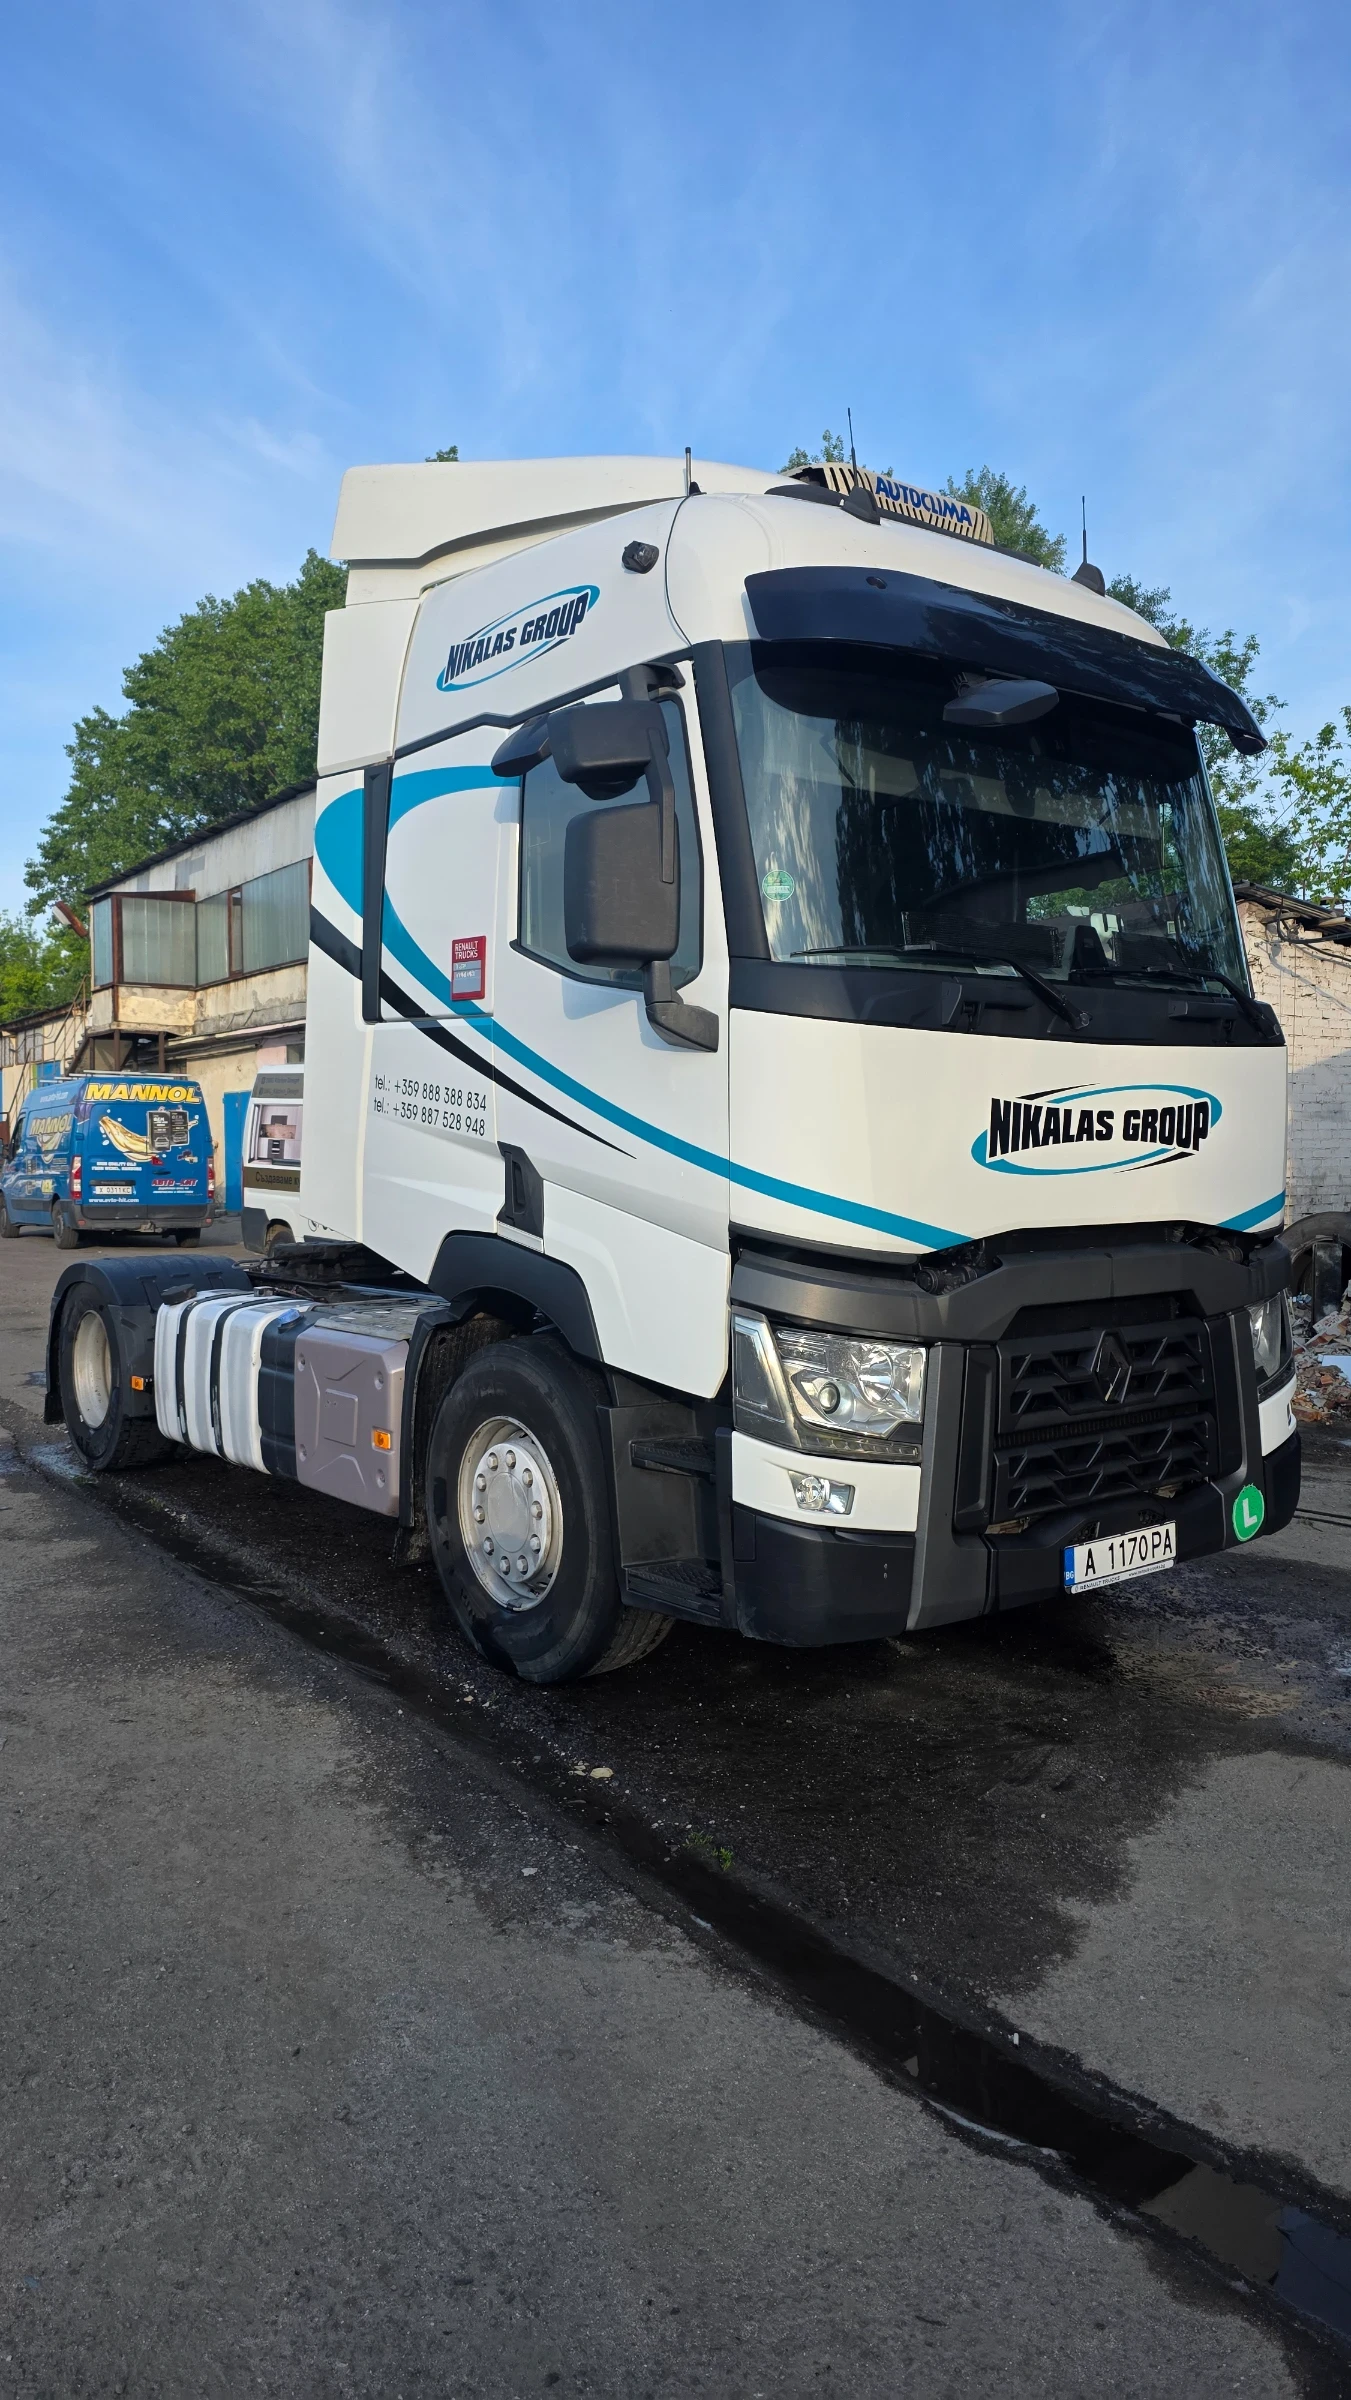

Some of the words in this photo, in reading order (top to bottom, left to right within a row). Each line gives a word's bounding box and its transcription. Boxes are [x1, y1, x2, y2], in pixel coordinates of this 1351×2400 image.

[875, 476, 973, 527] AUTOCLIMA
[444, 627, 517, 684] NIKALAS
[519, 591, 589, 646] GROUP
[454, 941, 479, 952] RENAULT
[454, 950, 479, 960] TRUCKS
[83, 1083, 201, 1104] MANNOL
[375, 1074, 391, 1092] tel.:
[394, 1078, 420, 1098] +359
[422, 1083, 441, 1102] 888
[443, 1087, 463, 1107] 388
[466, 1091, 487, 1111] 834
[29, 1113, 74, 1136] MANNOL
[373, 1097, 389, 1114] tel.:
[393, 1101, 418, 1121] +359
[421, 1106, 440, 1126] 887
[442, 1111, 462, 1131] 528
[465, 1116, 486, 1136] 948
[989, 1097, 1115, 1158] NIKALAS
[1122, 1100, 1210, 1152] GROUP
[1242, 1497, 1258, 1528] L
[1065, 1571, 1075, 1580] BG
[1084, 1547, 1096, 1577] A
[1108, 1528, 1173, 1570] 1170PA
